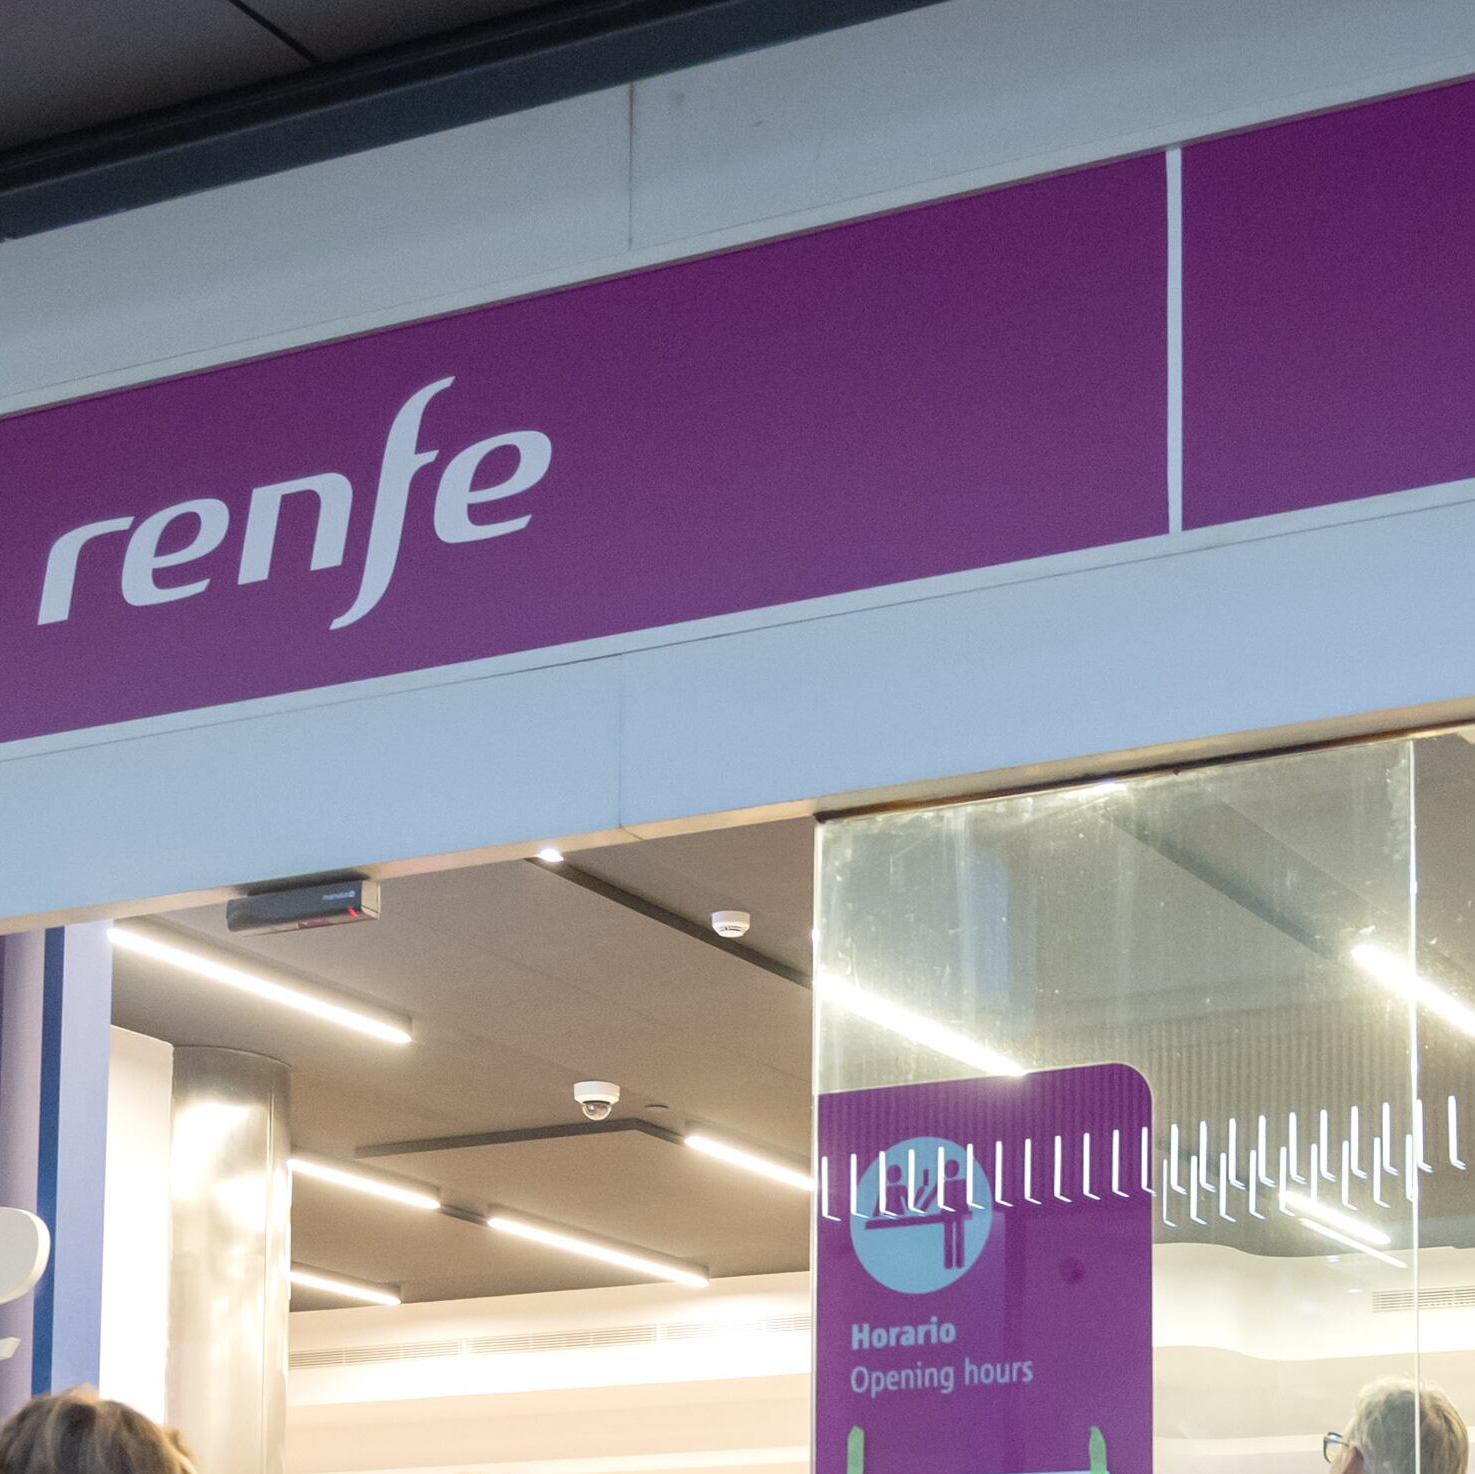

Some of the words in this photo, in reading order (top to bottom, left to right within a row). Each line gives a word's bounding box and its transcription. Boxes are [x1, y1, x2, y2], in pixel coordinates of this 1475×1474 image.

[37, 375, 554, 631] renfe
[850, 1314, 956, 1351] Horario
[850, 1357, 955, 1398] Opening
[964, 1355, 1034, 1388] hours
